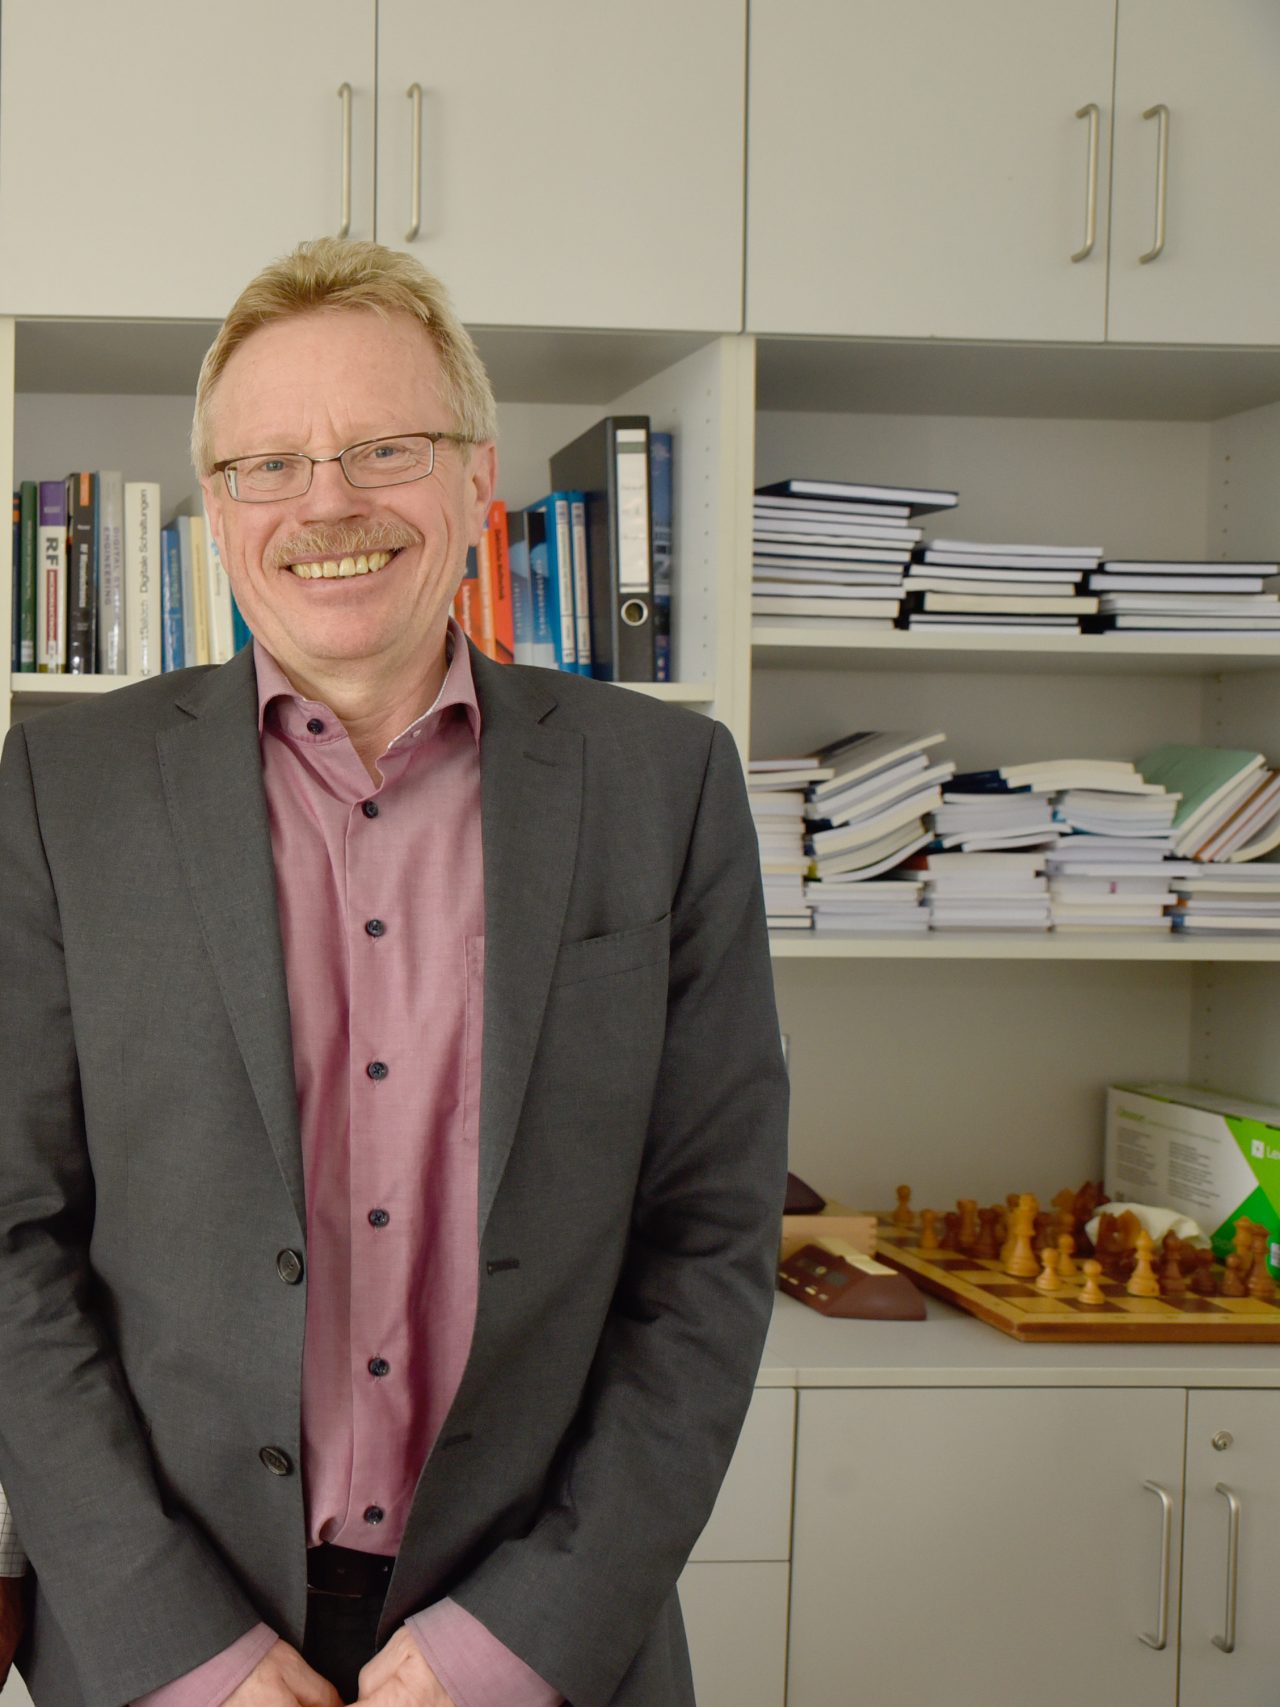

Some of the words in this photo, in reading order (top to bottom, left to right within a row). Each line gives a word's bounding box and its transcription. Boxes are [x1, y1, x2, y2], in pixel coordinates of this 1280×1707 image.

[139, 489, 149, 553] Schaltungen
[46, 537, 59, 566] RF
[140, 555, 149, 593] Digitale
